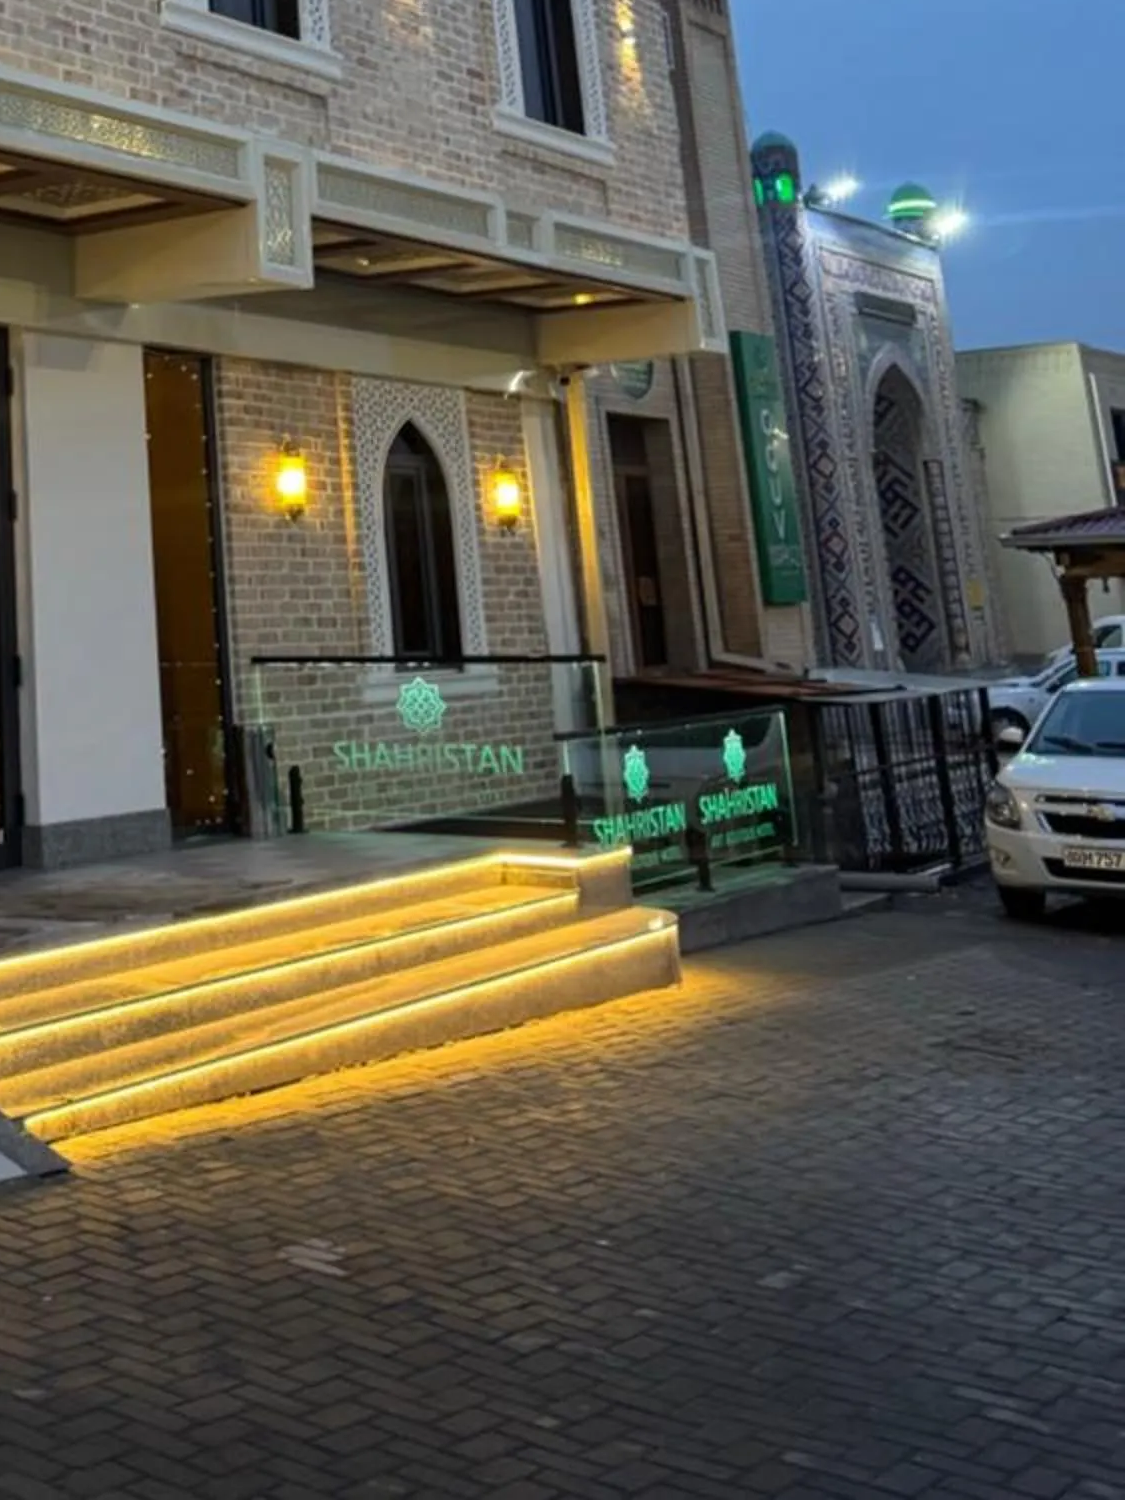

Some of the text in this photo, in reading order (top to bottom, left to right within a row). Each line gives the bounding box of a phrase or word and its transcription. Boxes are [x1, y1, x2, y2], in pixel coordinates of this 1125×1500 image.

[333, 739, 524, 775] SHAHRISTAN
[699, 783, 778, 825] SHAHRISTAN
[593, 802, 686, 849] SHAHRISTAN
